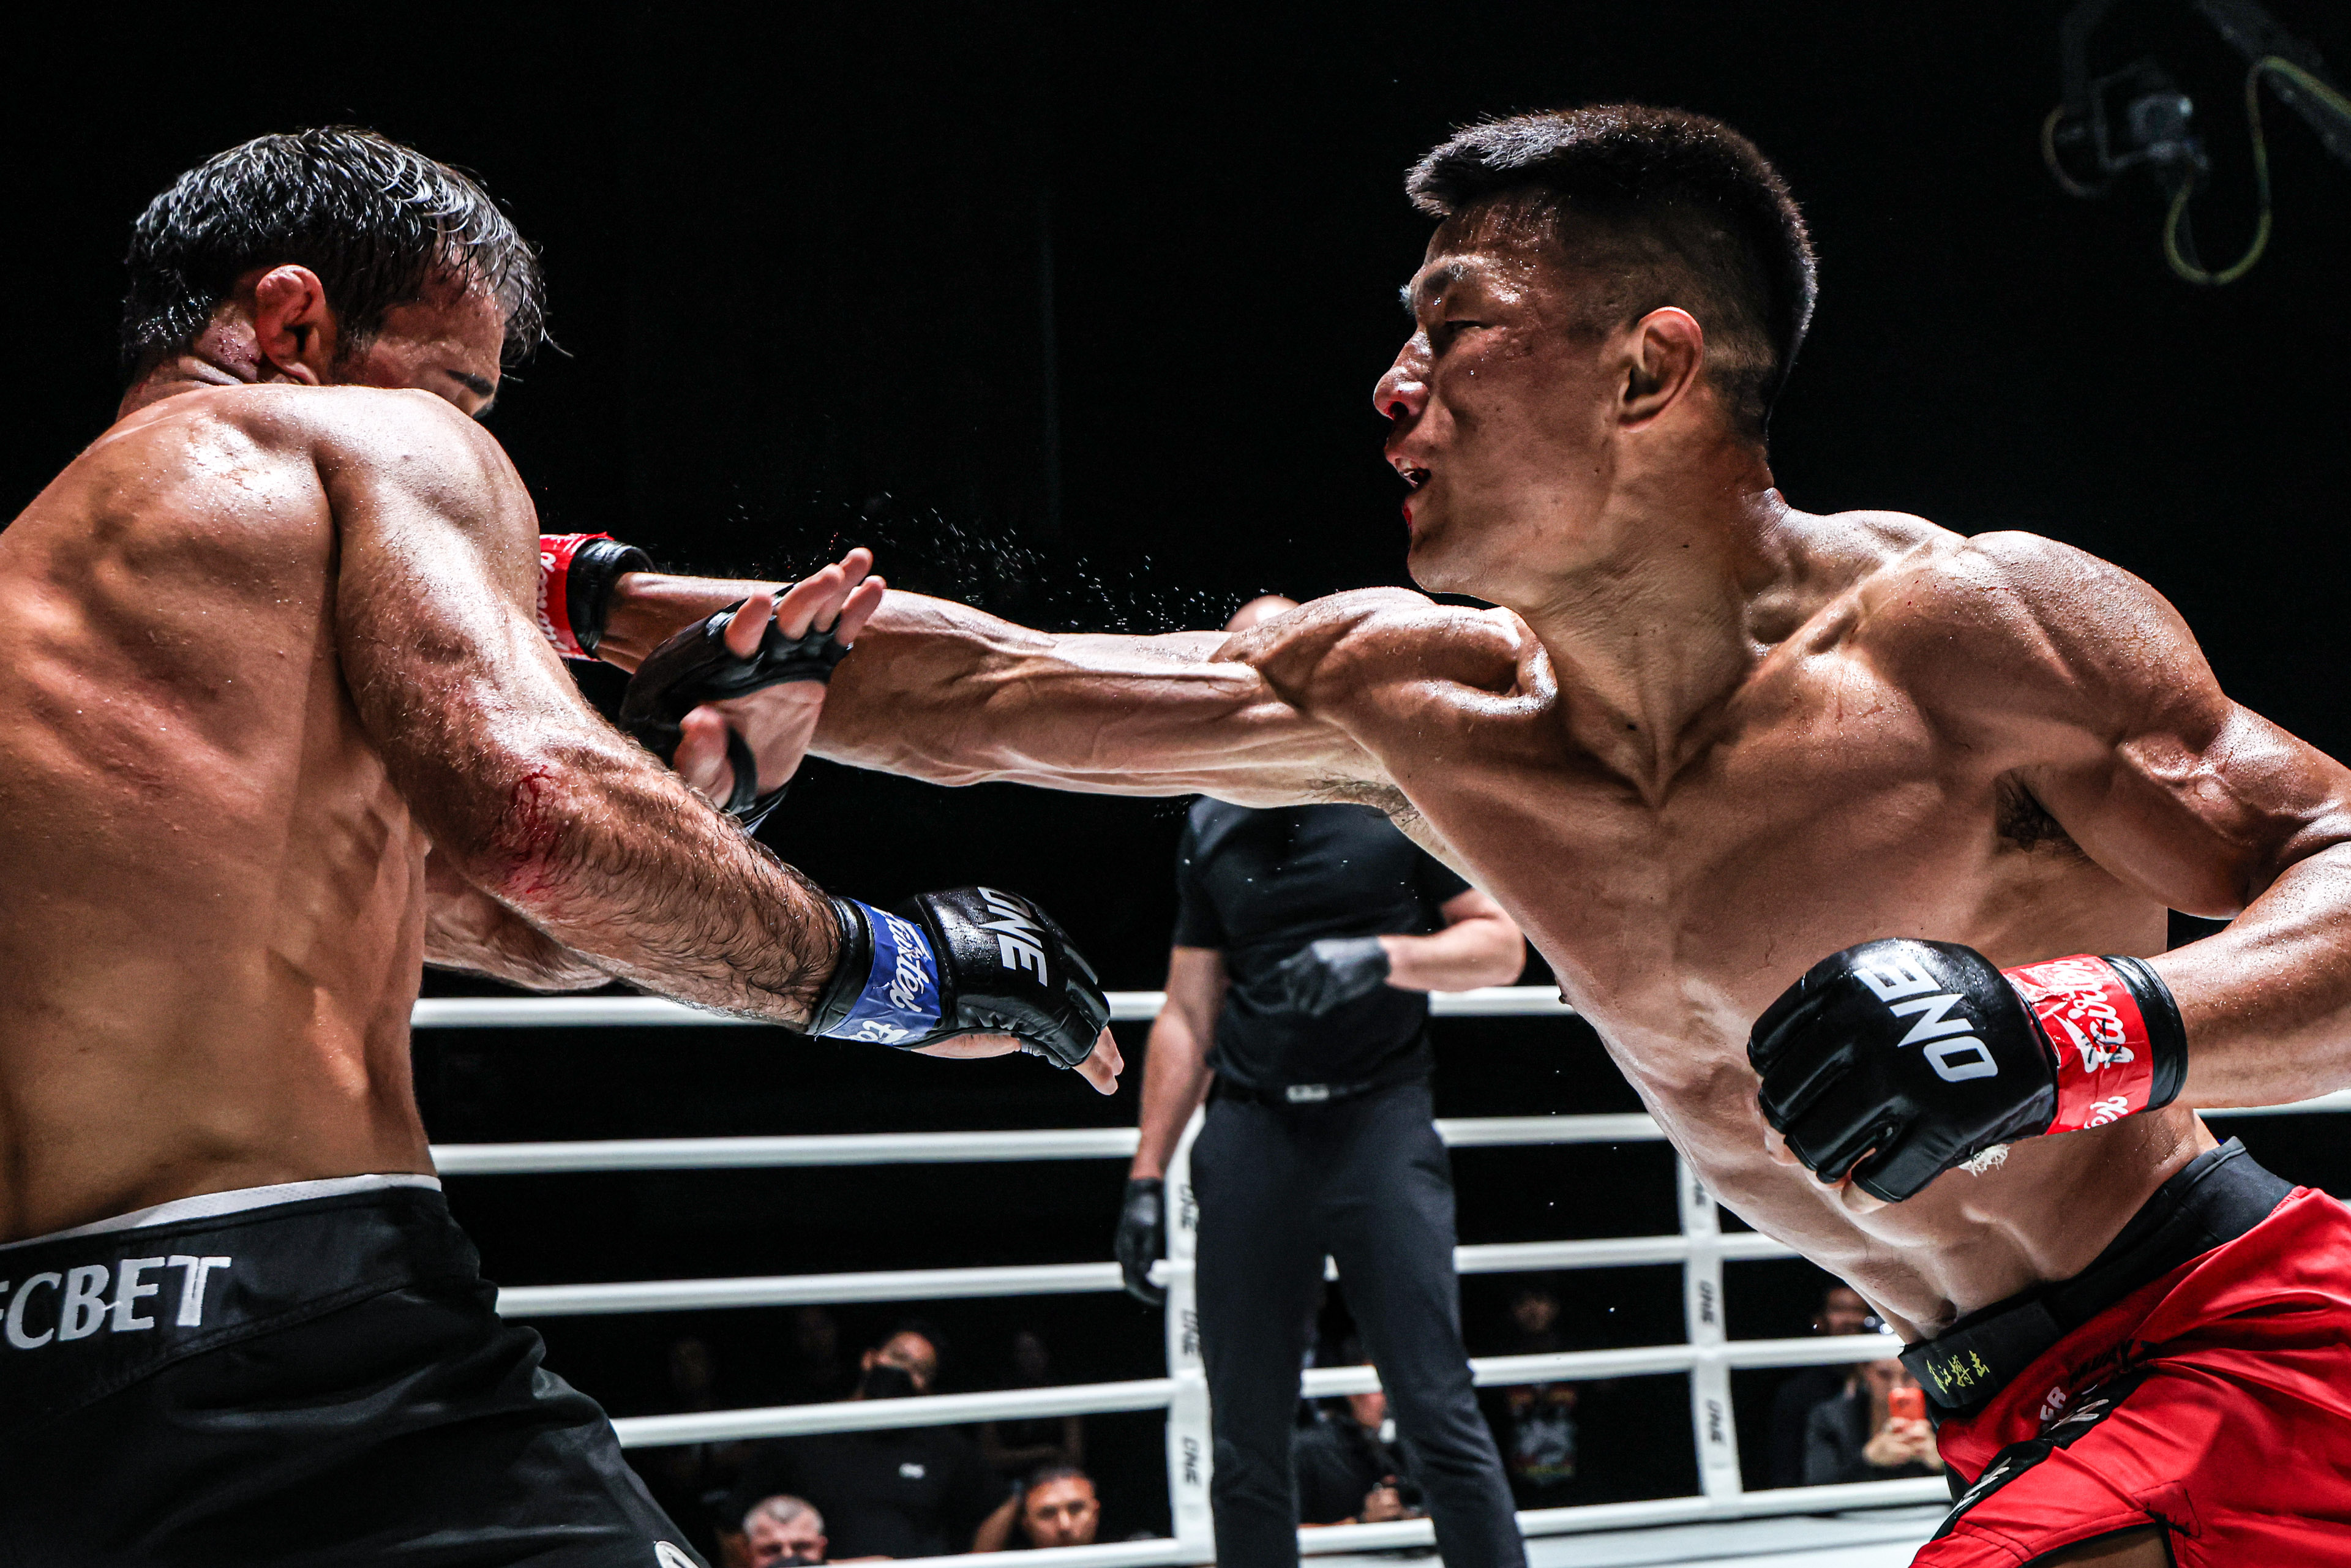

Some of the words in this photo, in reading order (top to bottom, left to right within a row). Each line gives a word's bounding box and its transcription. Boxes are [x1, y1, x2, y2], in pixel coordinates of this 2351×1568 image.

[978, 886, 1048, 988] ONE
[1853, 962, 1999, 1082] ONE
[0, 1255, 232, 1349] CBET
